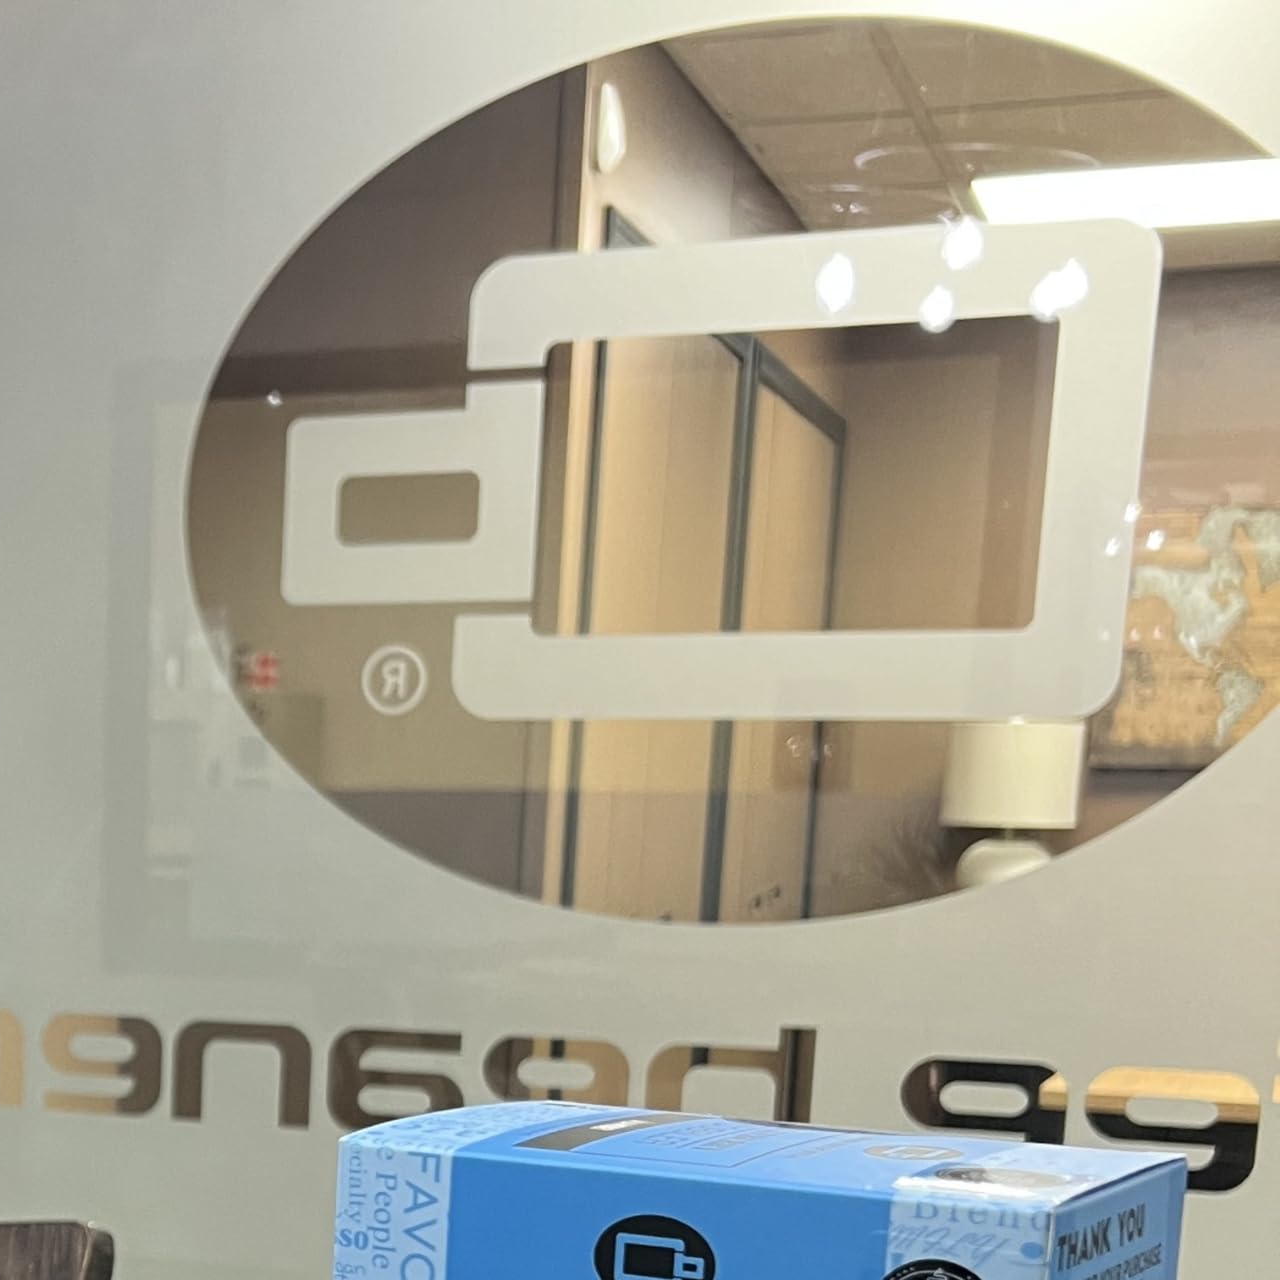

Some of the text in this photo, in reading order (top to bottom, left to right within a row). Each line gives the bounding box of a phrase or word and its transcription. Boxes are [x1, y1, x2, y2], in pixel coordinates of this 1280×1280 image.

[367, 1172, 398, 1270] People
[1057, 1216, 1112, 1272] THANK
[1117, 1203, 1146, 1247] YOU
